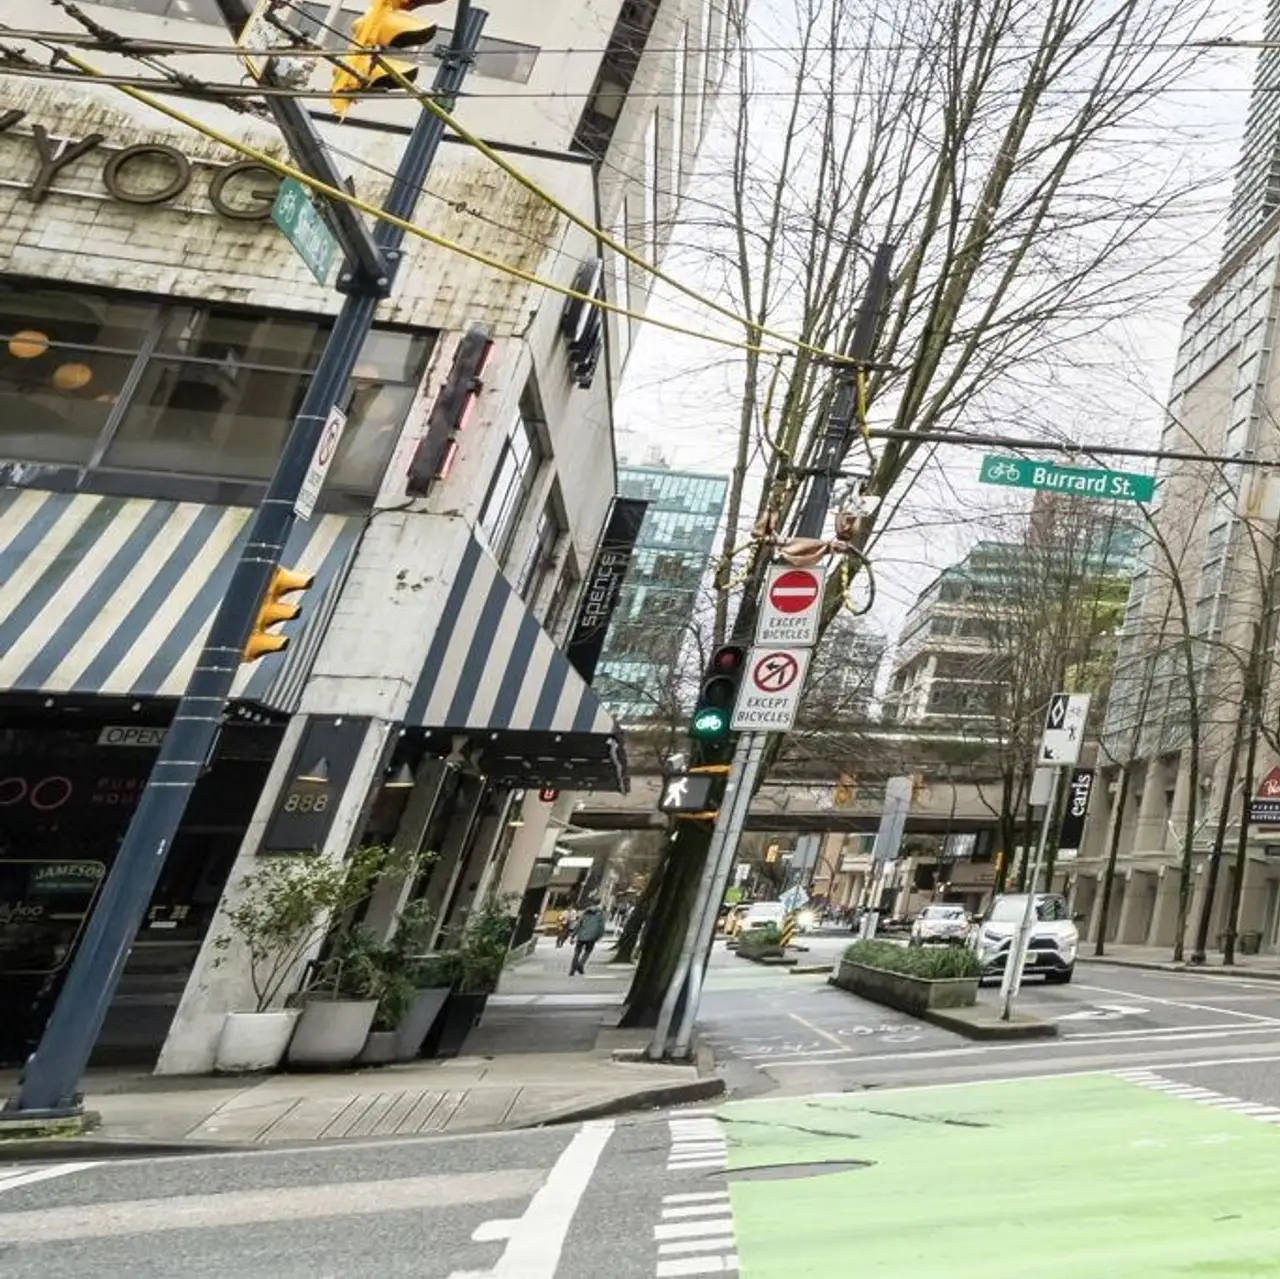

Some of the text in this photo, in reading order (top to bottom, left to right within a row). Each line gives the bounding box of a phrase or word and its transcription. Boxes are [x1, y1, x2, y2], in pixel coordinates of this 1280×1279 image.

[1032, 467, 1136, 497] Burrard St.
[769, 617, 808, 628] EXCEPT
[763, 628, 810, 640] BICYCLES
[747, 698, 789, 708] EXCEPT
[737, 711, 790, 722] BICYCLES
[1070, 773, 1092, 817] earls
[284, 793, 329, 813] 888
